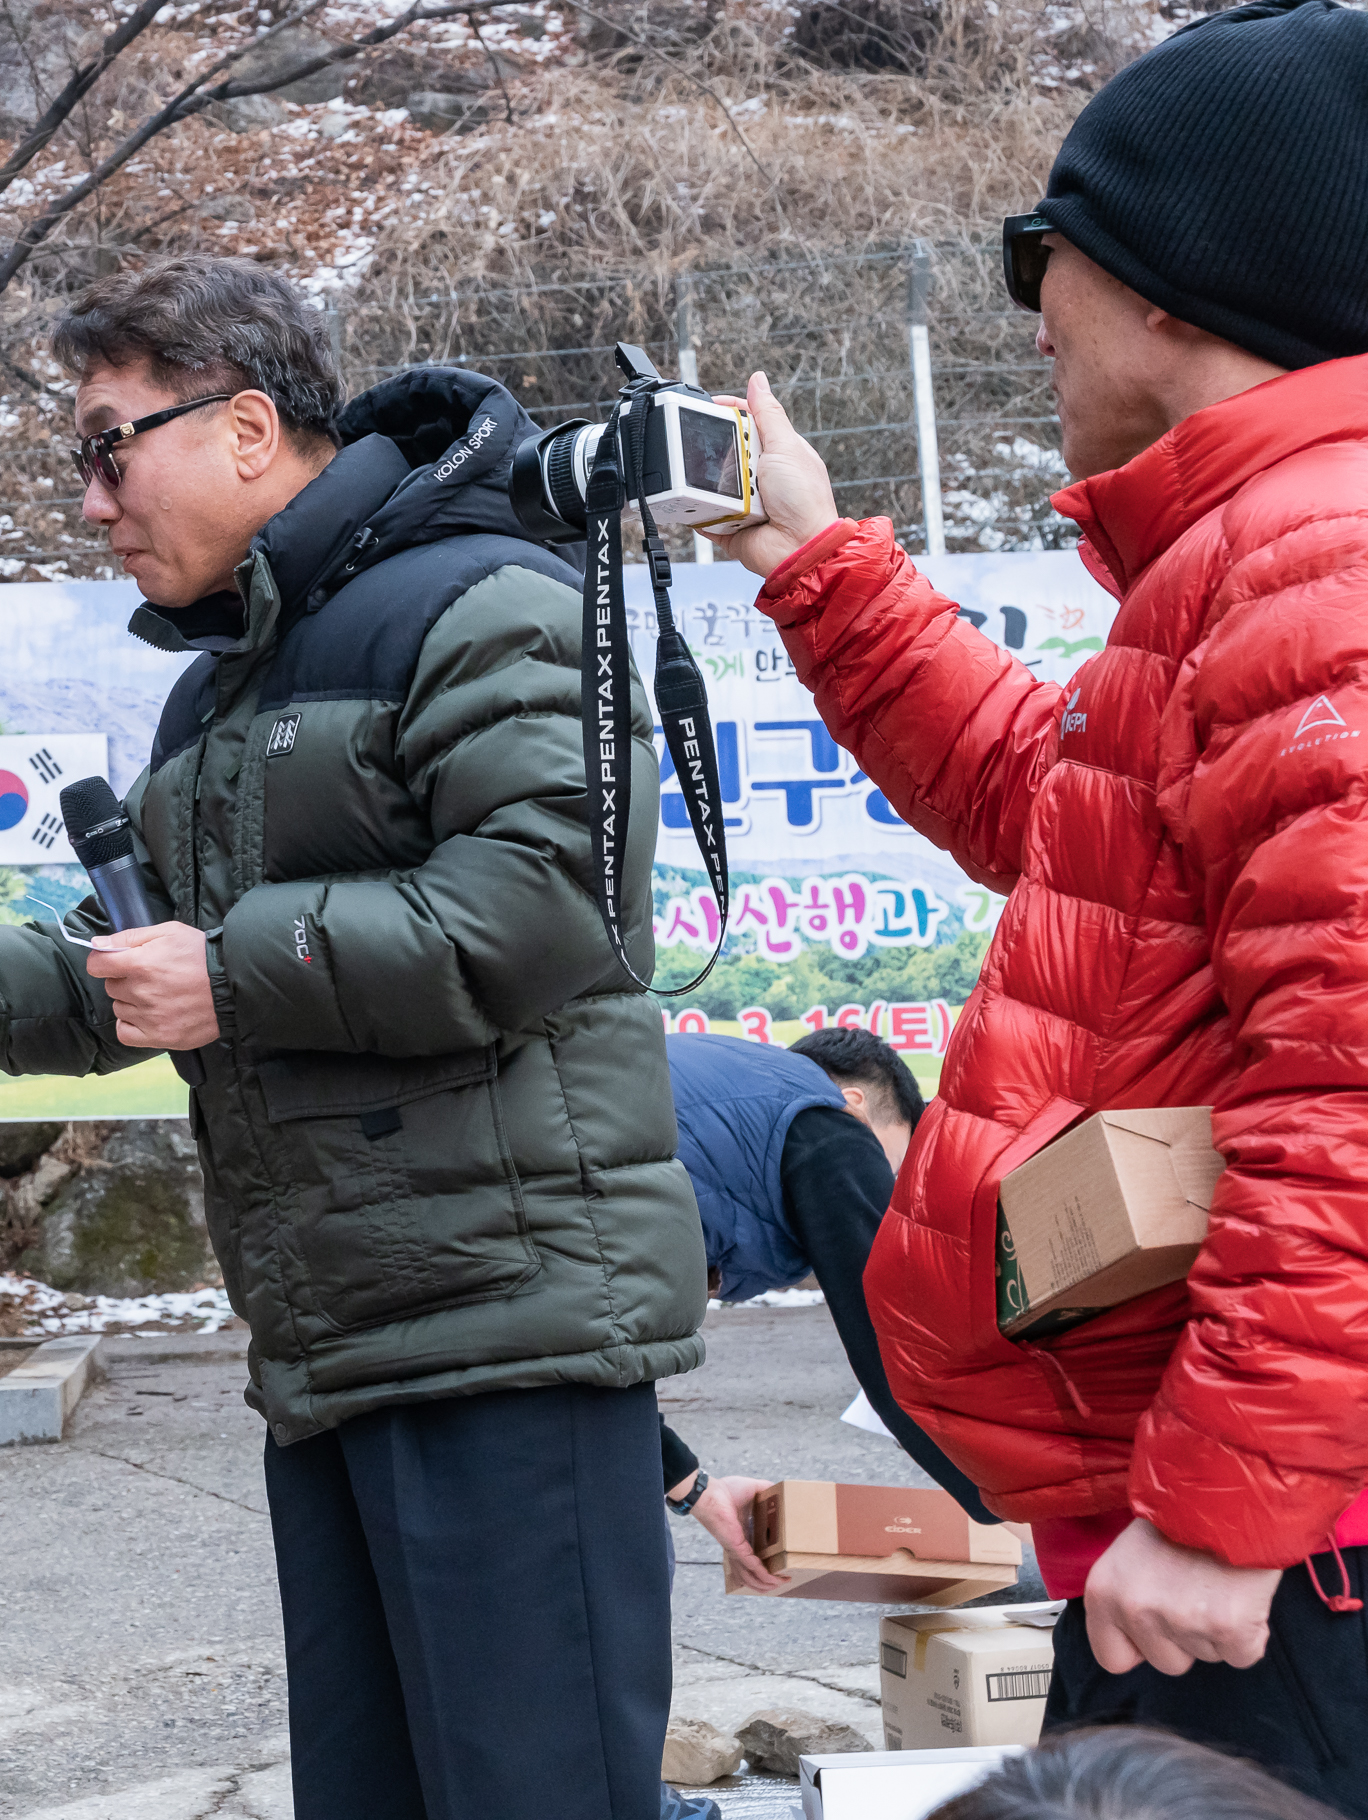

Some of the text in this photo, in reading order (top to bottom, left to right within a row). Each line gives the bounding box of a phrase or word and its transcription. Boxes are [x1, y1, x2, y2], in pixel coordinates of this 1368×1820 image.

[434, 417, 498, 482] KOLON SPORT
[597, 518, 617, 918] PENTAX PENTAX PENTAX
[678, 716, 717, 847] PENTAX
